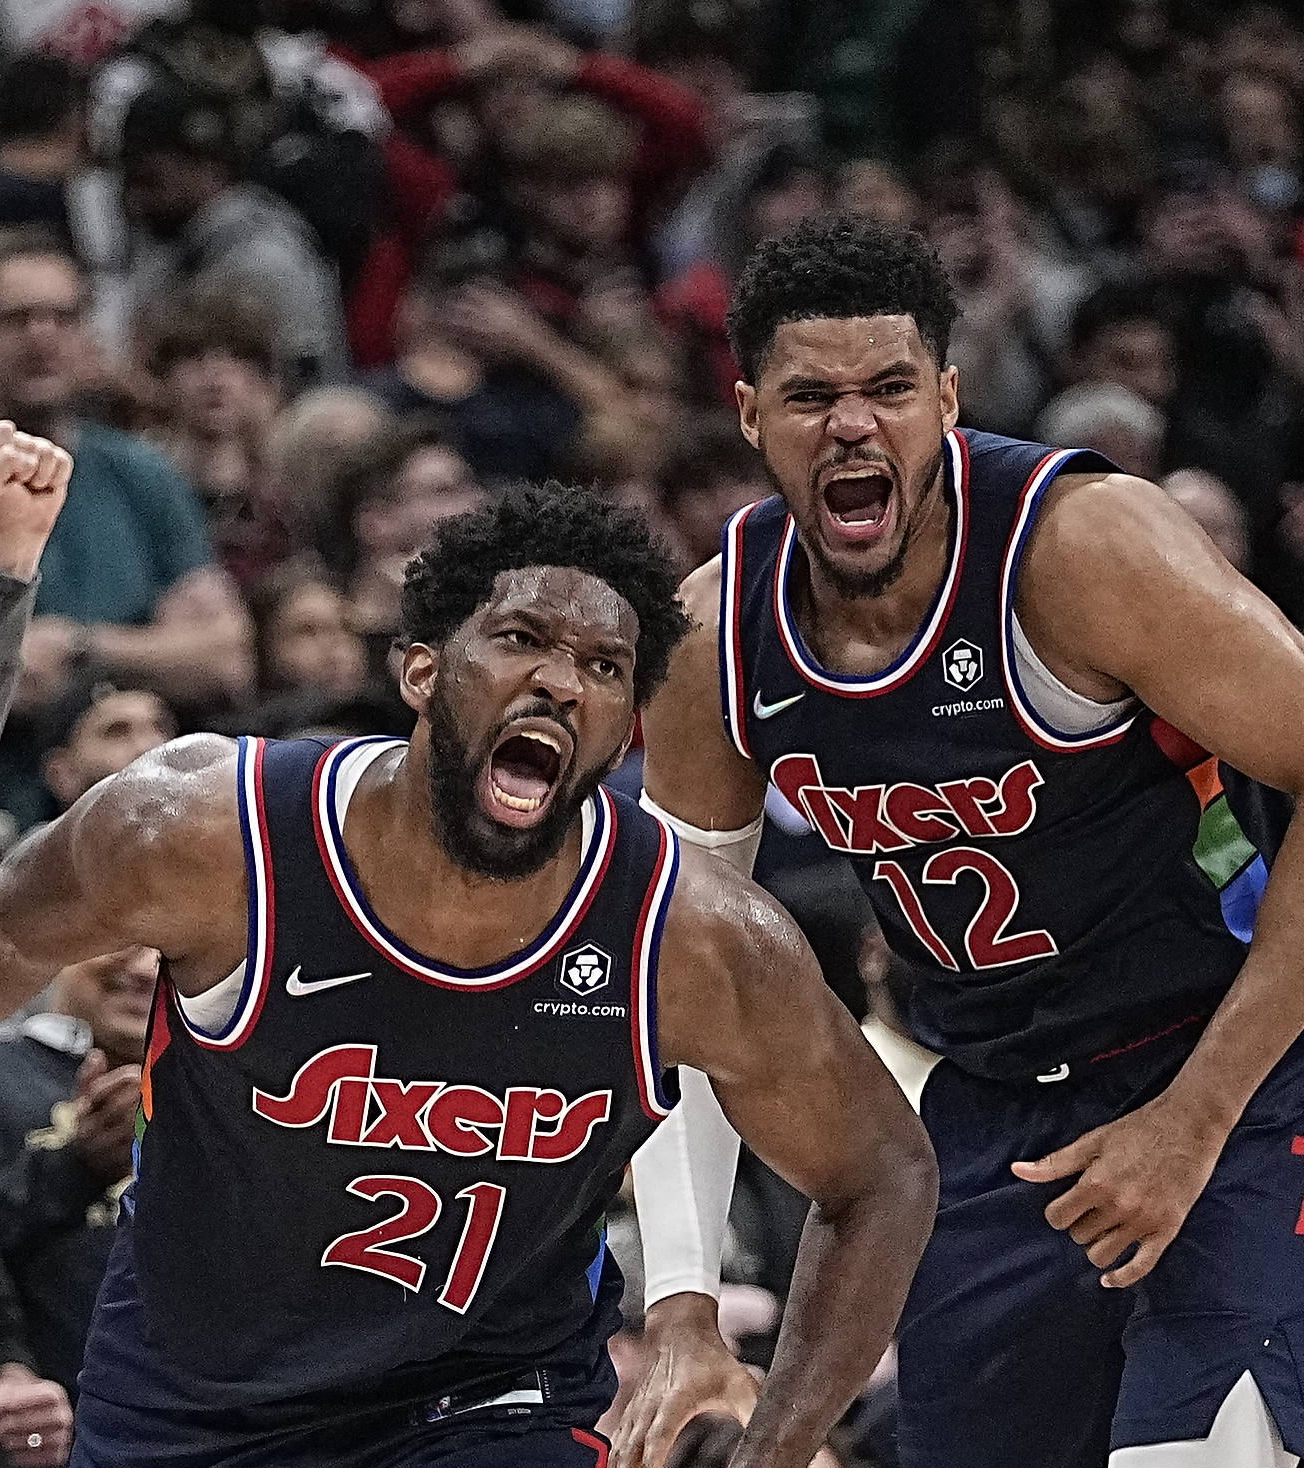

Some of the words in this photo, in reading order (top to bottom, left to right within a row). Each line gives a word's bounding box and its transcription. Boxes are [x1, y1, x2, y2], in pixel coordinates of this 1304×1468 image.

[931, 694, 1004, 717] crypto.com
[872, 846, 1059, 971] 12
[533, 1000, 626, 1018] crypto.com
[320, 1174, 507, 1315] 21
